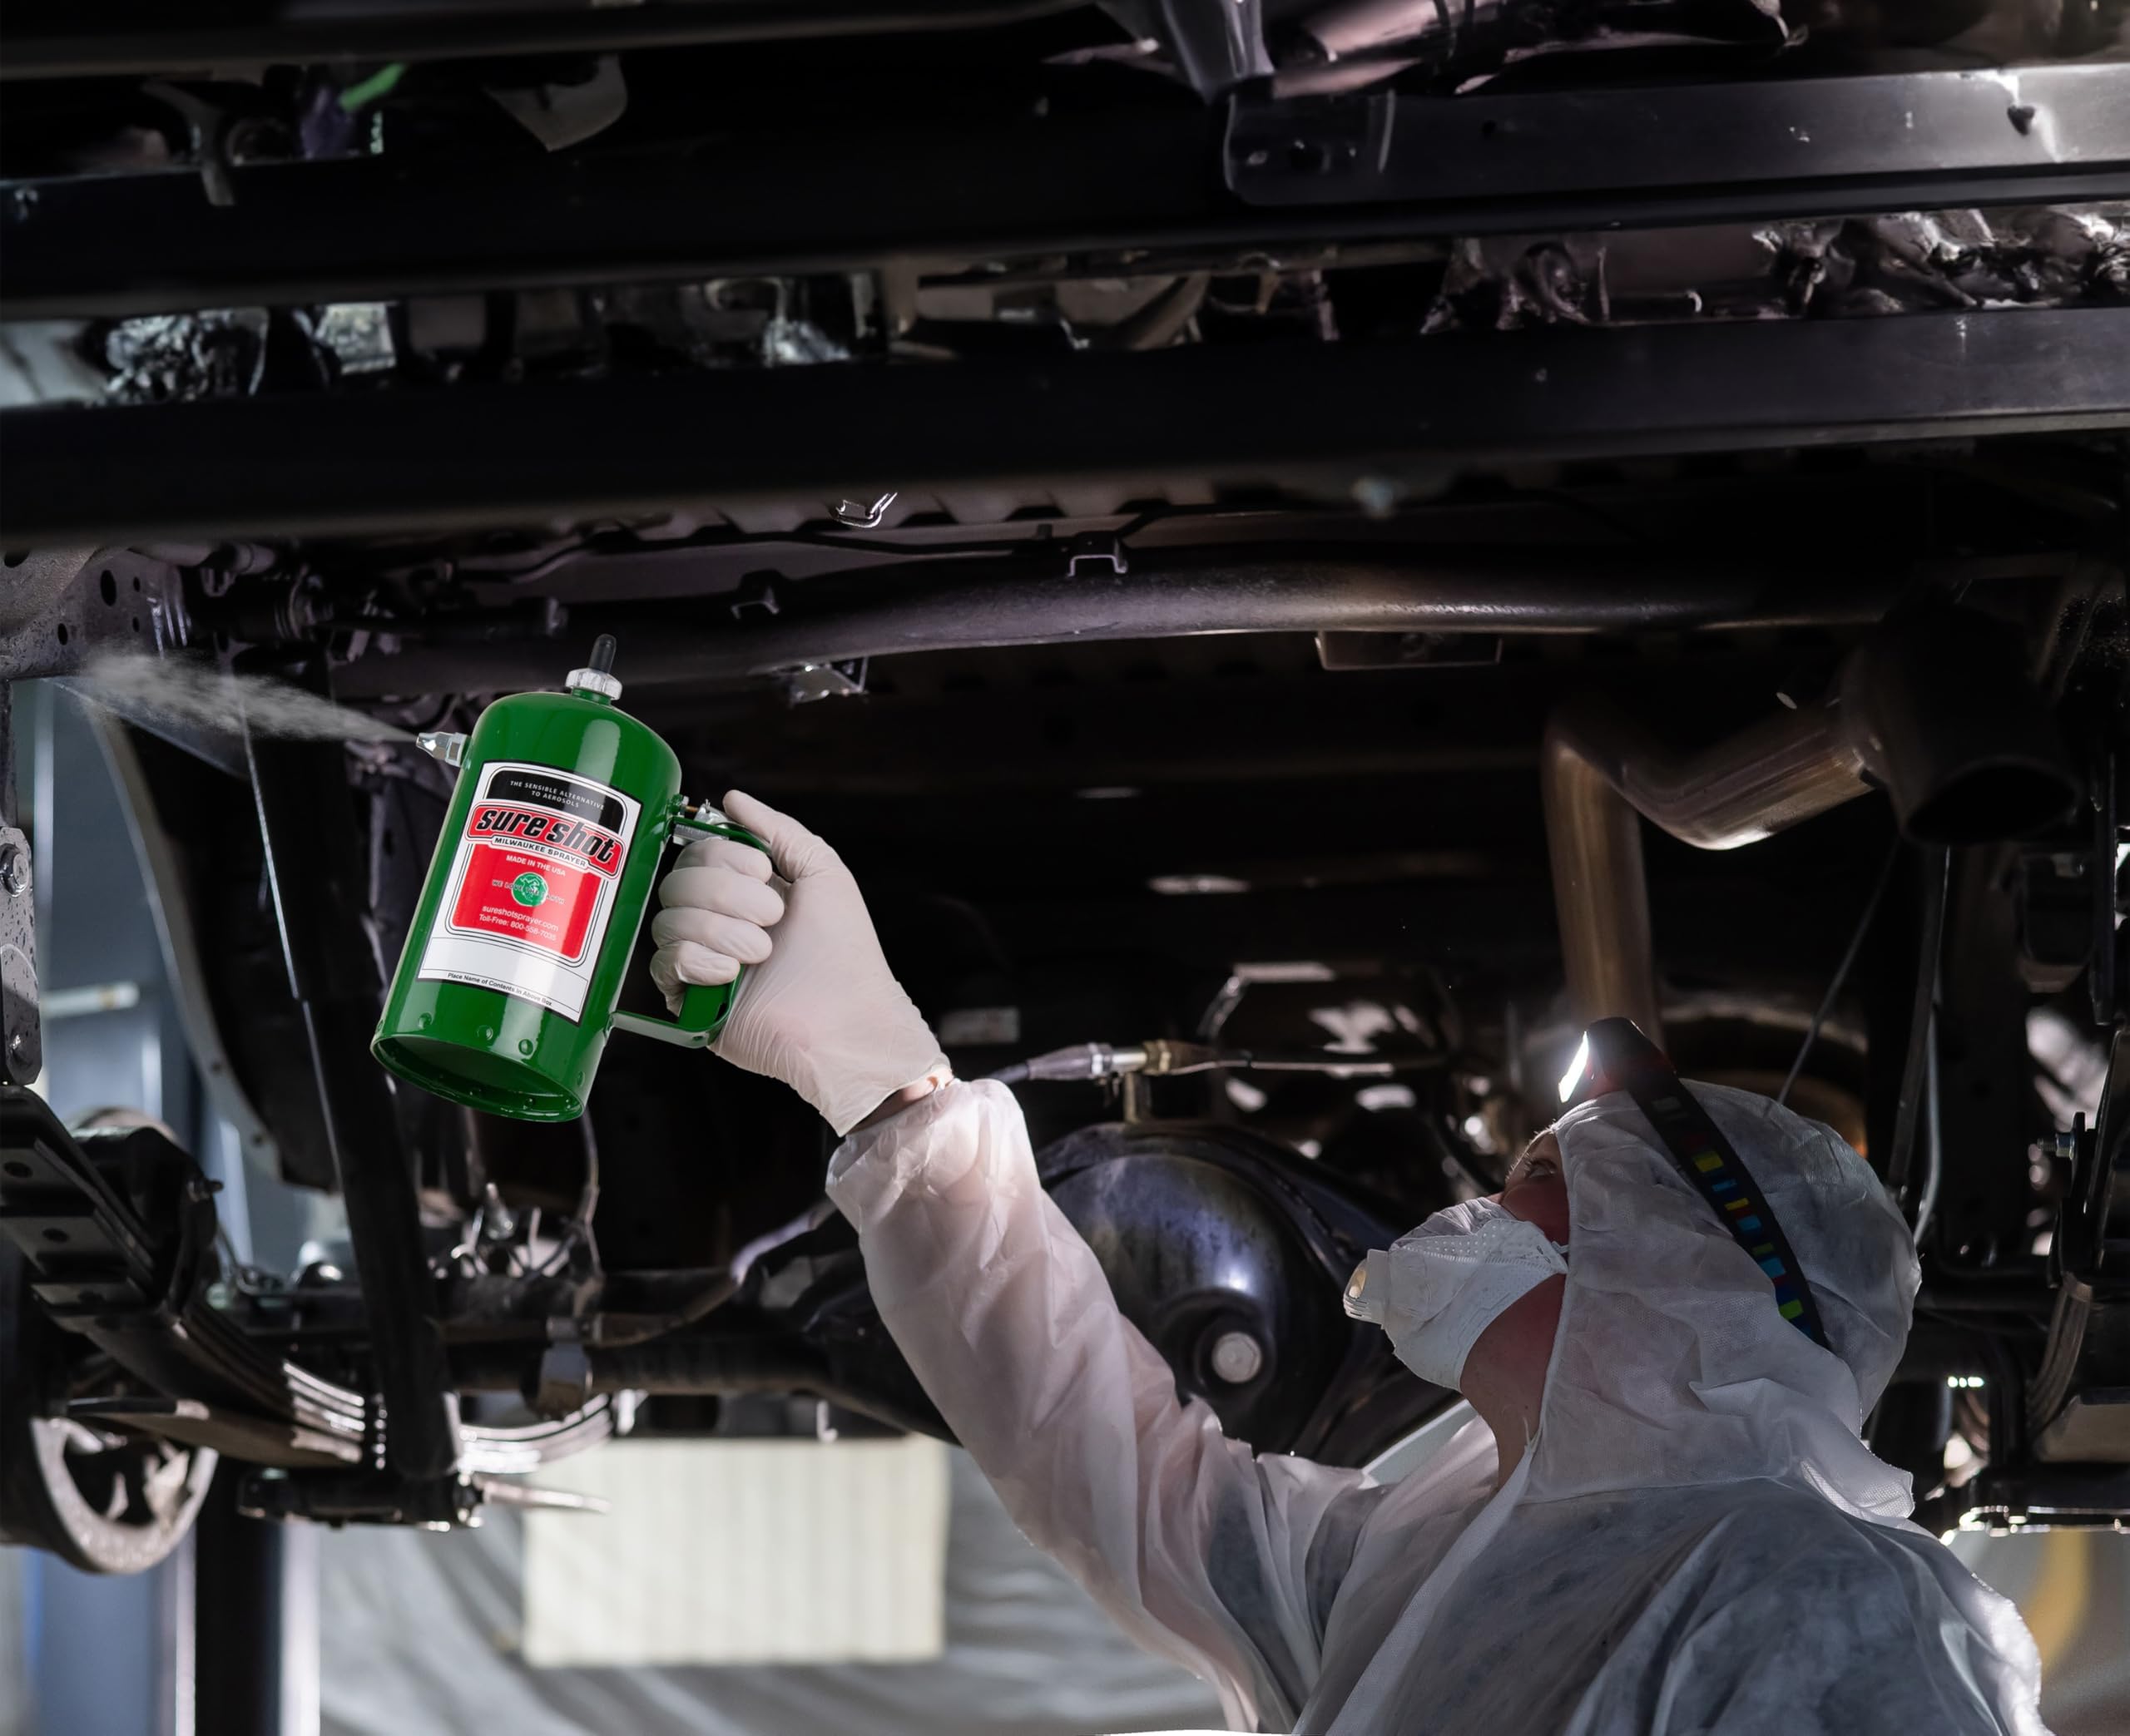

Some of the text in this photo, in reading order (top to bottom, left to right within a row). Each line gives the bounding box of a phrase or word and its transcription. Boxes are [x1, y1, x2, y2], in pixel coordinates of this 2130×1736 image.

[524, 783, 557, 794] SENSIBLE
[559, 790, 604, 810] ALTERNATIVE
[542, 793, 579, 808] AEROSOLS
[475, 809, 617, 863] sure shot
[494, 837, 586, 867] MILWAUKEE SPRAYER
[506, 855, 527, 864] MADE
[537, 863, 551, 871] THE
[552, 867, 566, 876] USA
[504, 882, 523, 892] LOVE
[479, 914, 508, 925] Toll-Free:
[482, 906, 559, 932] sureshotsprayer.com
[463, 975, 480, 983] Name
[488, 981, 515, 992] Contents
[523, 991, 542, 1001] Above
